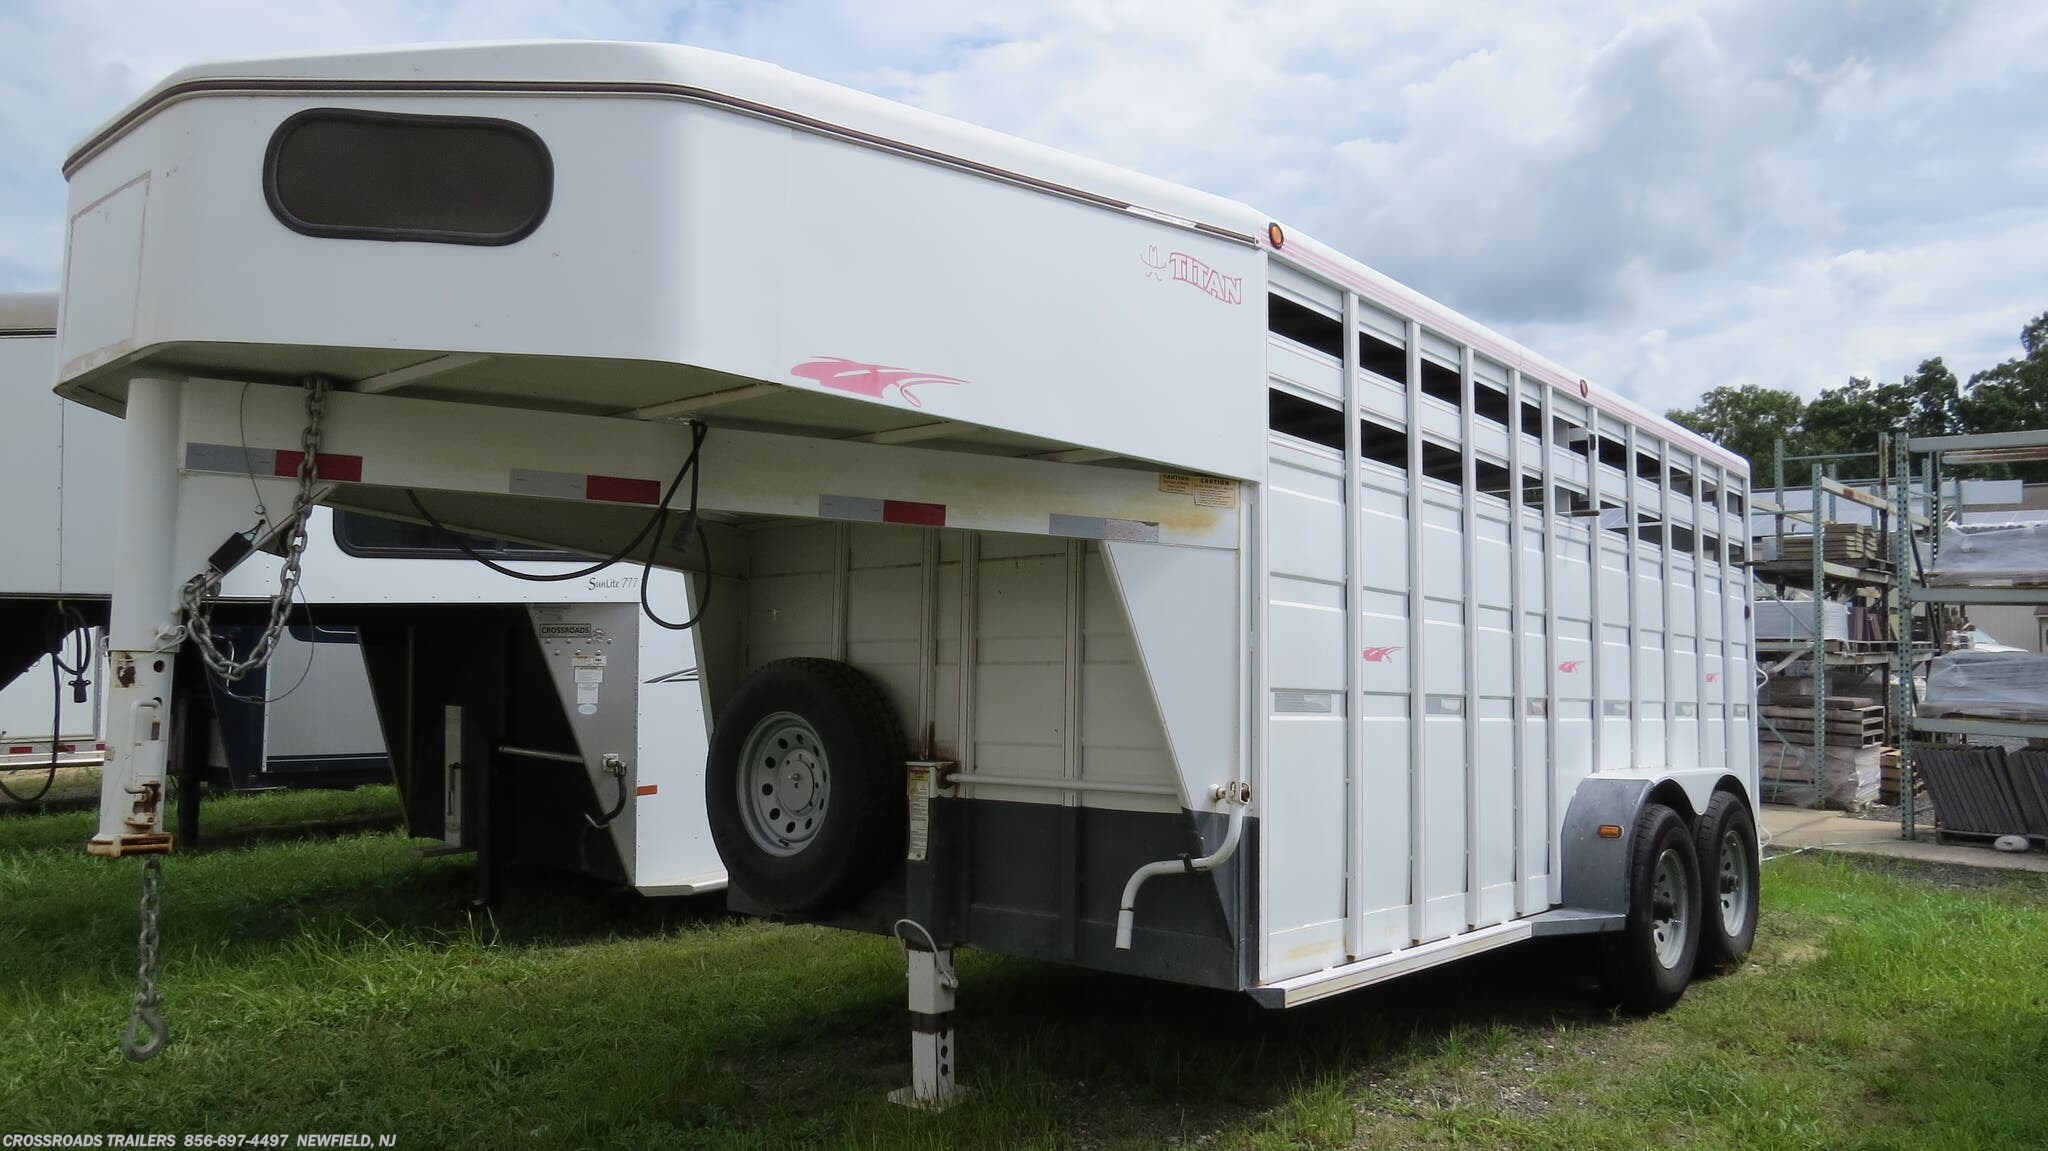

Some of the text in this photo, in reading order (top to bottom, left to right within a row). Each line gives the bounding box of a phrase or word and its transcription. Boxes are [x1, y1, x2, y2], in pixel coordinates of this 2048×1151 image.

[1168, 252, 1242, 304] TITAN
[1163, 473, 1190, 482] CAUTION
[1200, 477, 1230, 486] CAUTION
[588, 577, 639, 590] SunLite 777
[541, 626, 589, 634] CROSSROADS
